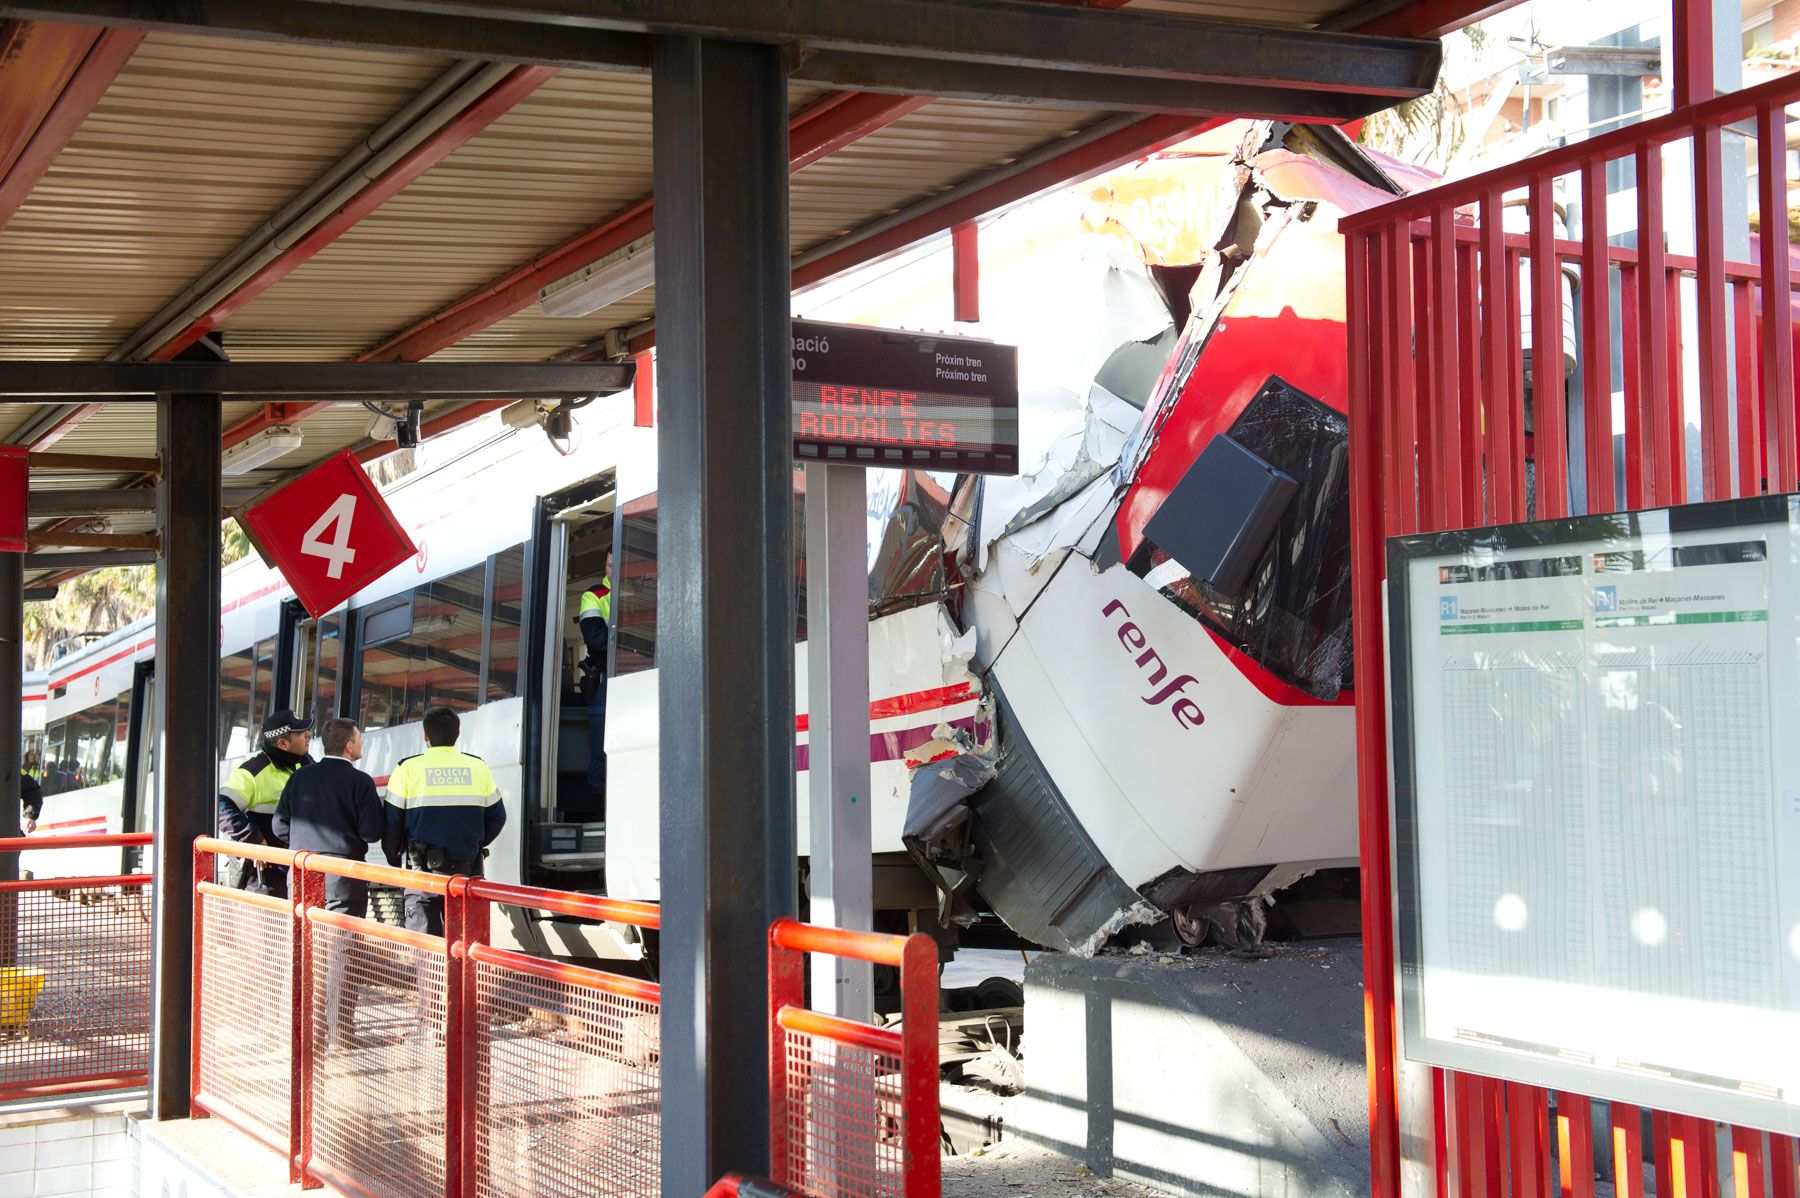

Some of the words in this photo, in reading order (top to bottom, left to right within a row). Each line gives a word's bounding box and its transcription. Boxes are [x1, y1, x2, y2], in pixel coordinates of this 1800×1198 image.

[936, 353, 964, 365] Pròxim
[966, 356, 982, 367] tren
[936, 368, 969, 380] Próximo
[971, 372, 987, 382] tren
[821, 385, 919, 417] RENFE
[800, 412, 956, 446] RODALIES
[301, 493, 358, 580] 4
[1440, 601, 1455, 615] R1
[1102, 599, 1205, 730] renfe
[427, 768, 470, 777] POLICIA
[432, 776, 466, 785] LOCAL
